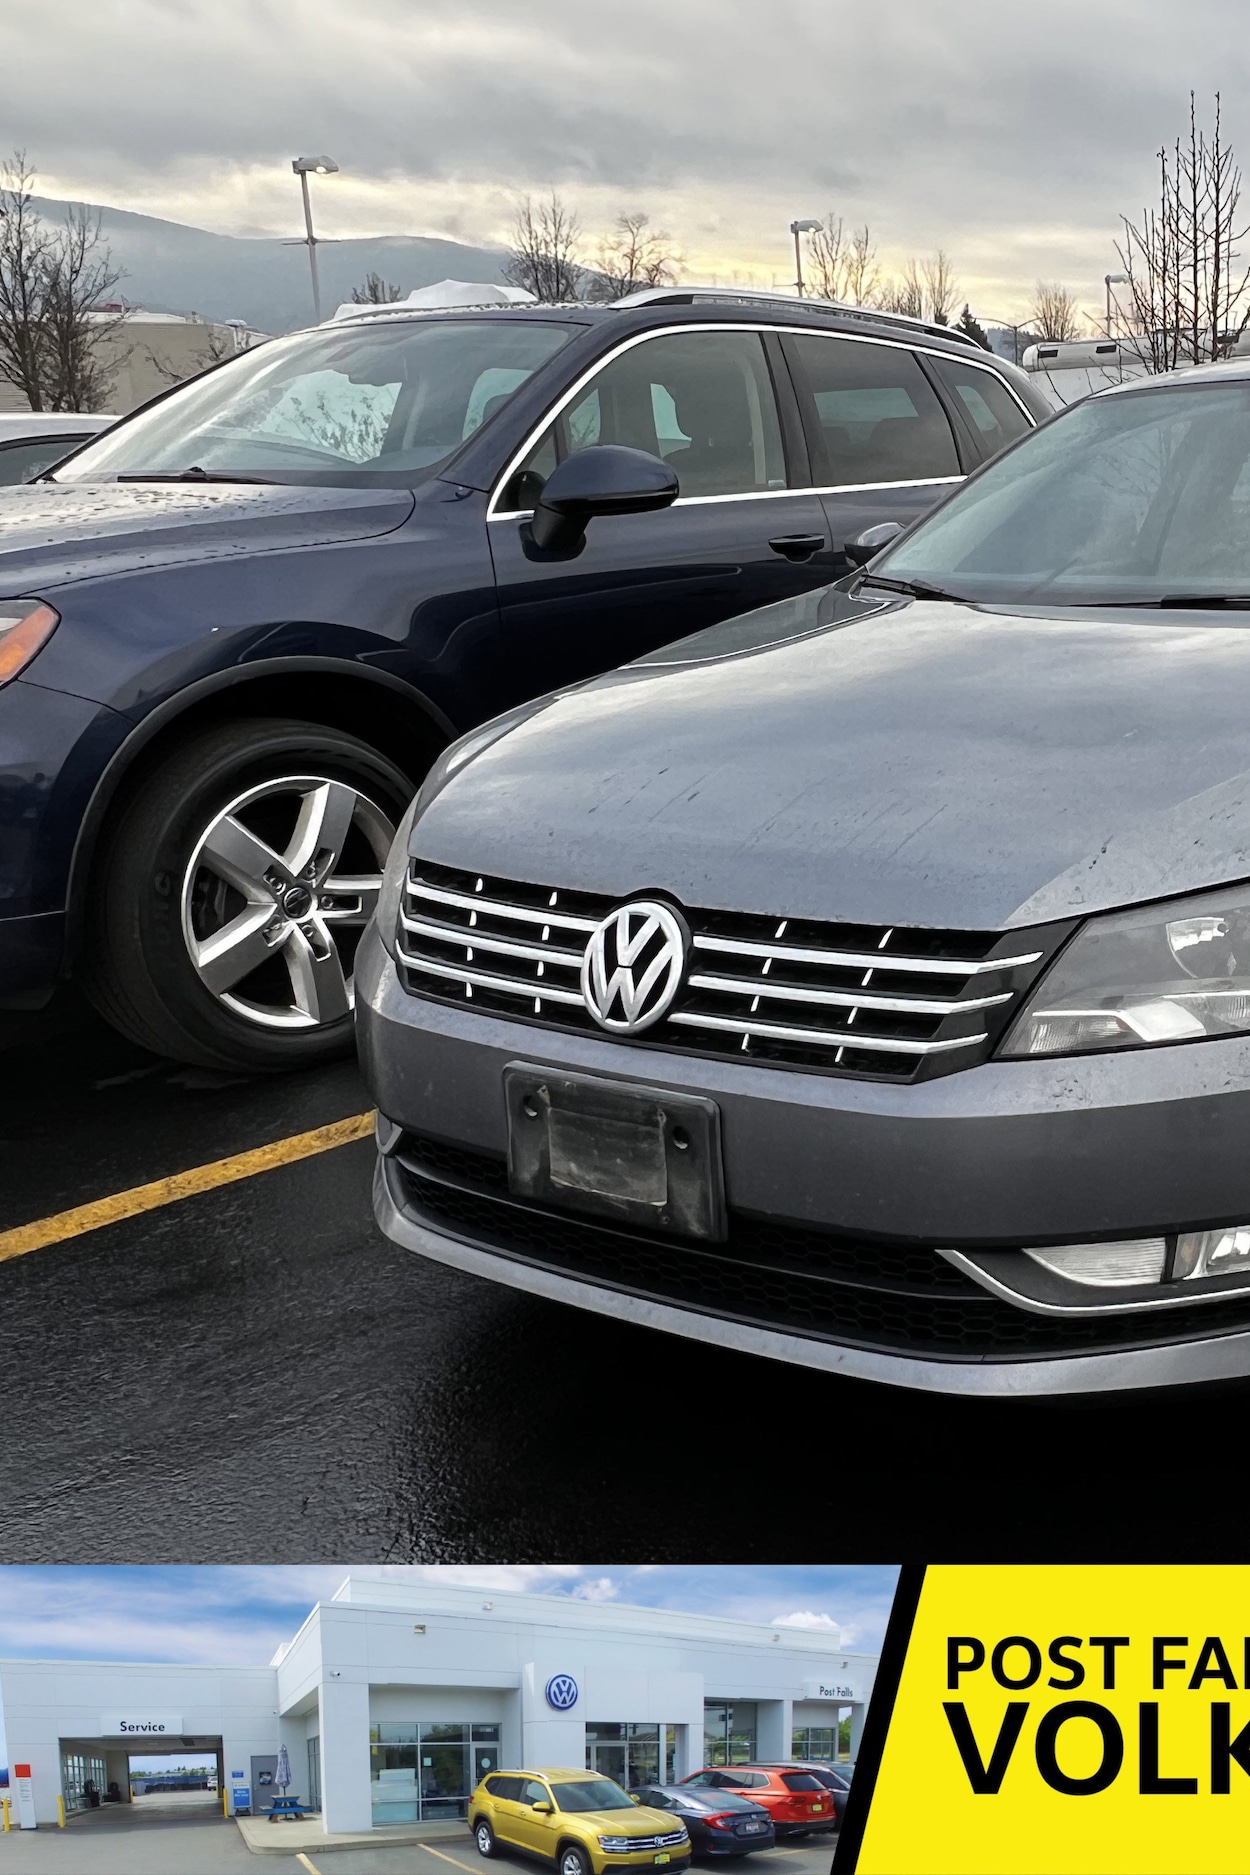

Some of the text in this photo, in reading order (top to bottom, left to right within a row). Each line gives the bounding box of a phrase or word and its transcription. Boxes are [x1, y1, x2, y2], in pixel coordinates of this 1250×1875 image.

[581, 902, 684, 1034] VW
[548, 1673, 578, 1710] VW
[819, 1685, 853, 1698] Post Falls
[119, 1720, 166, 1732] Service
